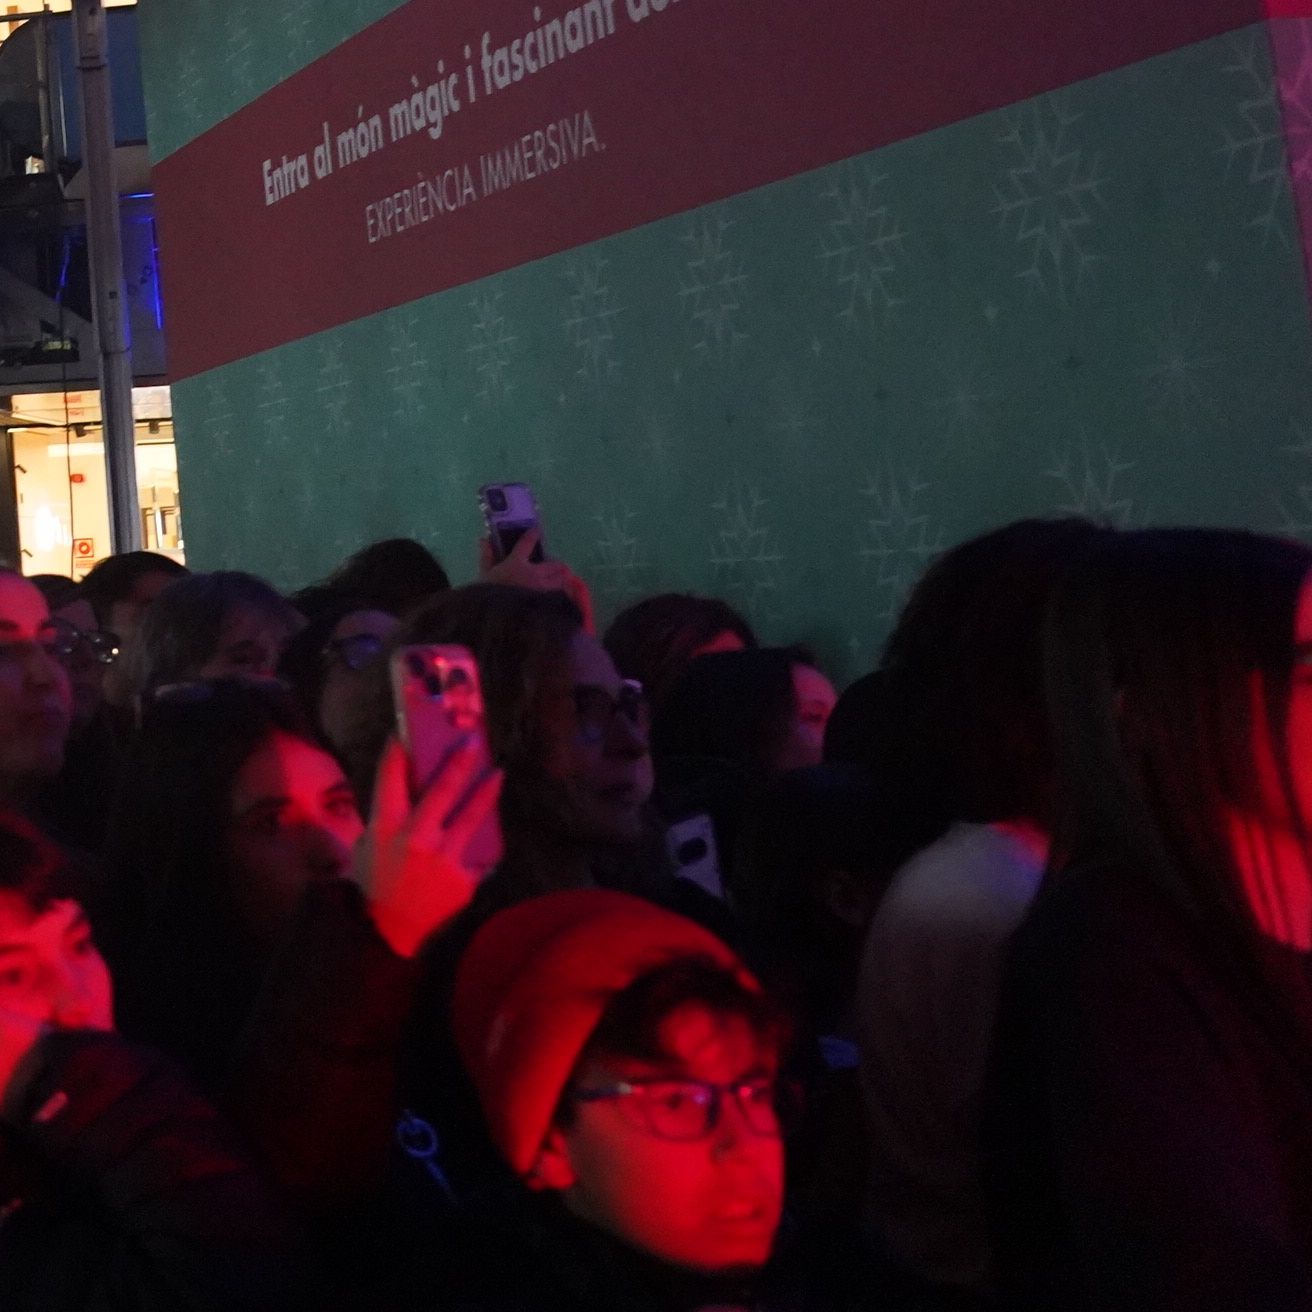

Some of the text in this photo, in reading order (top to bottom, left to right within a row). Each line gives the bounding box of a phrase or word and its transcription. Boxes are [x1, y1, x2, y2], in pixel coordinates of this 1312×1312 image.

[262, 159, 310, 206] Entra
[313, 121, 333, 180] al
[337, 105, 384, 168] món
[389, 59, 461, 140] màgic
[464, 44, 476, 103] i
[365, 109, 607, 244] EXPERIÈNCIA IMMERSIVA.
